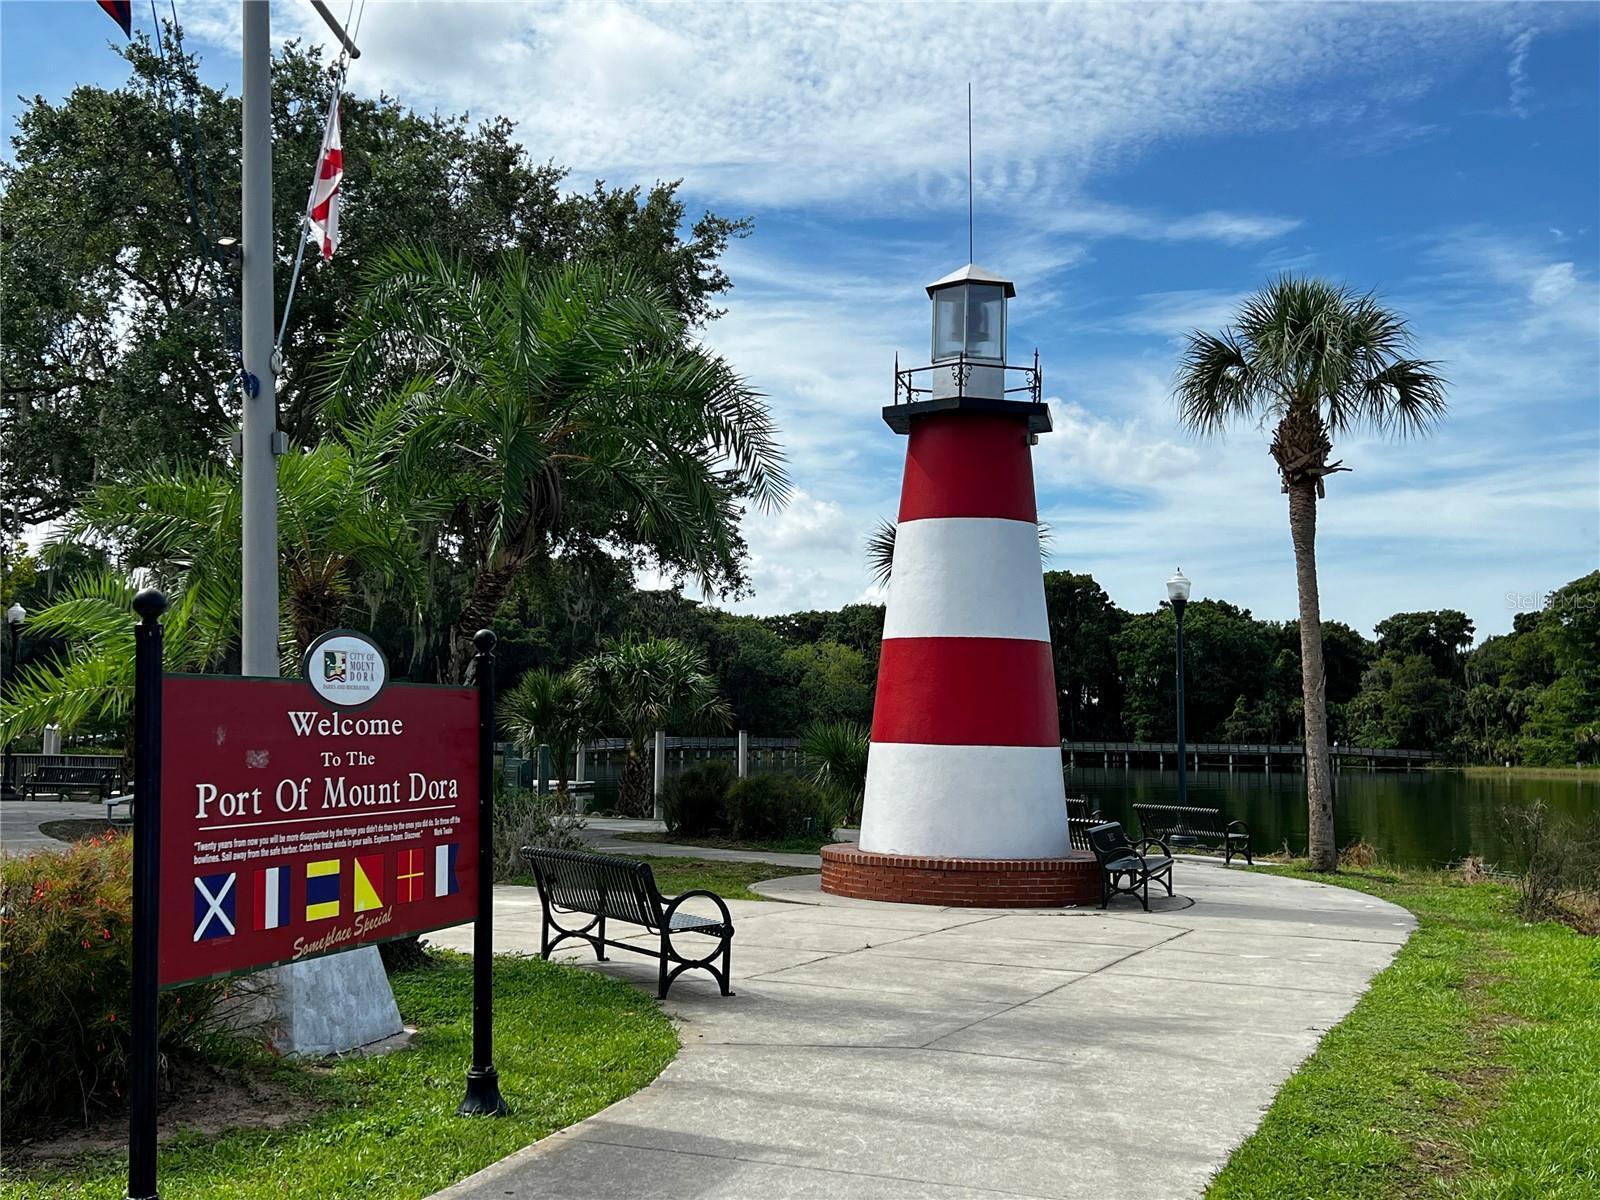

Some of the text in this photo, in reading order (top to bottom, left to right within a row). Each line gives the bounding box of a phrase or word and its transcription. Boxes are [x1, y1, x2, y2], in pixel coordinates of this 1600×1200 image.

[350, 652, 375, 661] CITY OF
[350, 661, 375, 671] MOUNT
[350, 672, 375, 681] DORA
[288, 711, 403, 736] Welcome
[320, 751, 375, 767] To The
[195, 772, 458, 819] Port Of Mount Dora
[217, 840, 233, 852] years
[233, 838, 247, 848] from
[247, 838, 258, 846] now
[258, 837, 269, 847] you
[269, 834, 279, 844] will
[279, 834, 286, 842] be
[286, 834, 299, 842] more
[300, 829, 329, 841] disappointed
[329, 828, 335, 839] by
[335, 828, 343, 837] the
[343, 827, 357, 837] things
[357, 827, 366, 837] you
[378, 823, 383, 832] do
[383, 823, 393, 832] than
[393, 822, 398, 832] by
[405, 821, 414, 829] ones
[414, 821, 422, 830] you
[434, 817, 440, 826] So
[439, 817, 450, 826] throw
[442, 826, 453, 835] Twain
[221, 851, 233, 861] Sail
[233, 851, 247, 861] away
[247, 849, 260, 859] from
[260, 847, 269, 857] the
[269, 846, 280, 856] safe
[299, 842, 313, 853] Catch
[313, 841, 321, 851] the
[321, 840, 333, 850] trade
[333, 839, 347, 848] winds
[347, 838, 352, 847] in
[352, 838, 362, 848] your
[292, 904, 393, 960] Someplace Special
